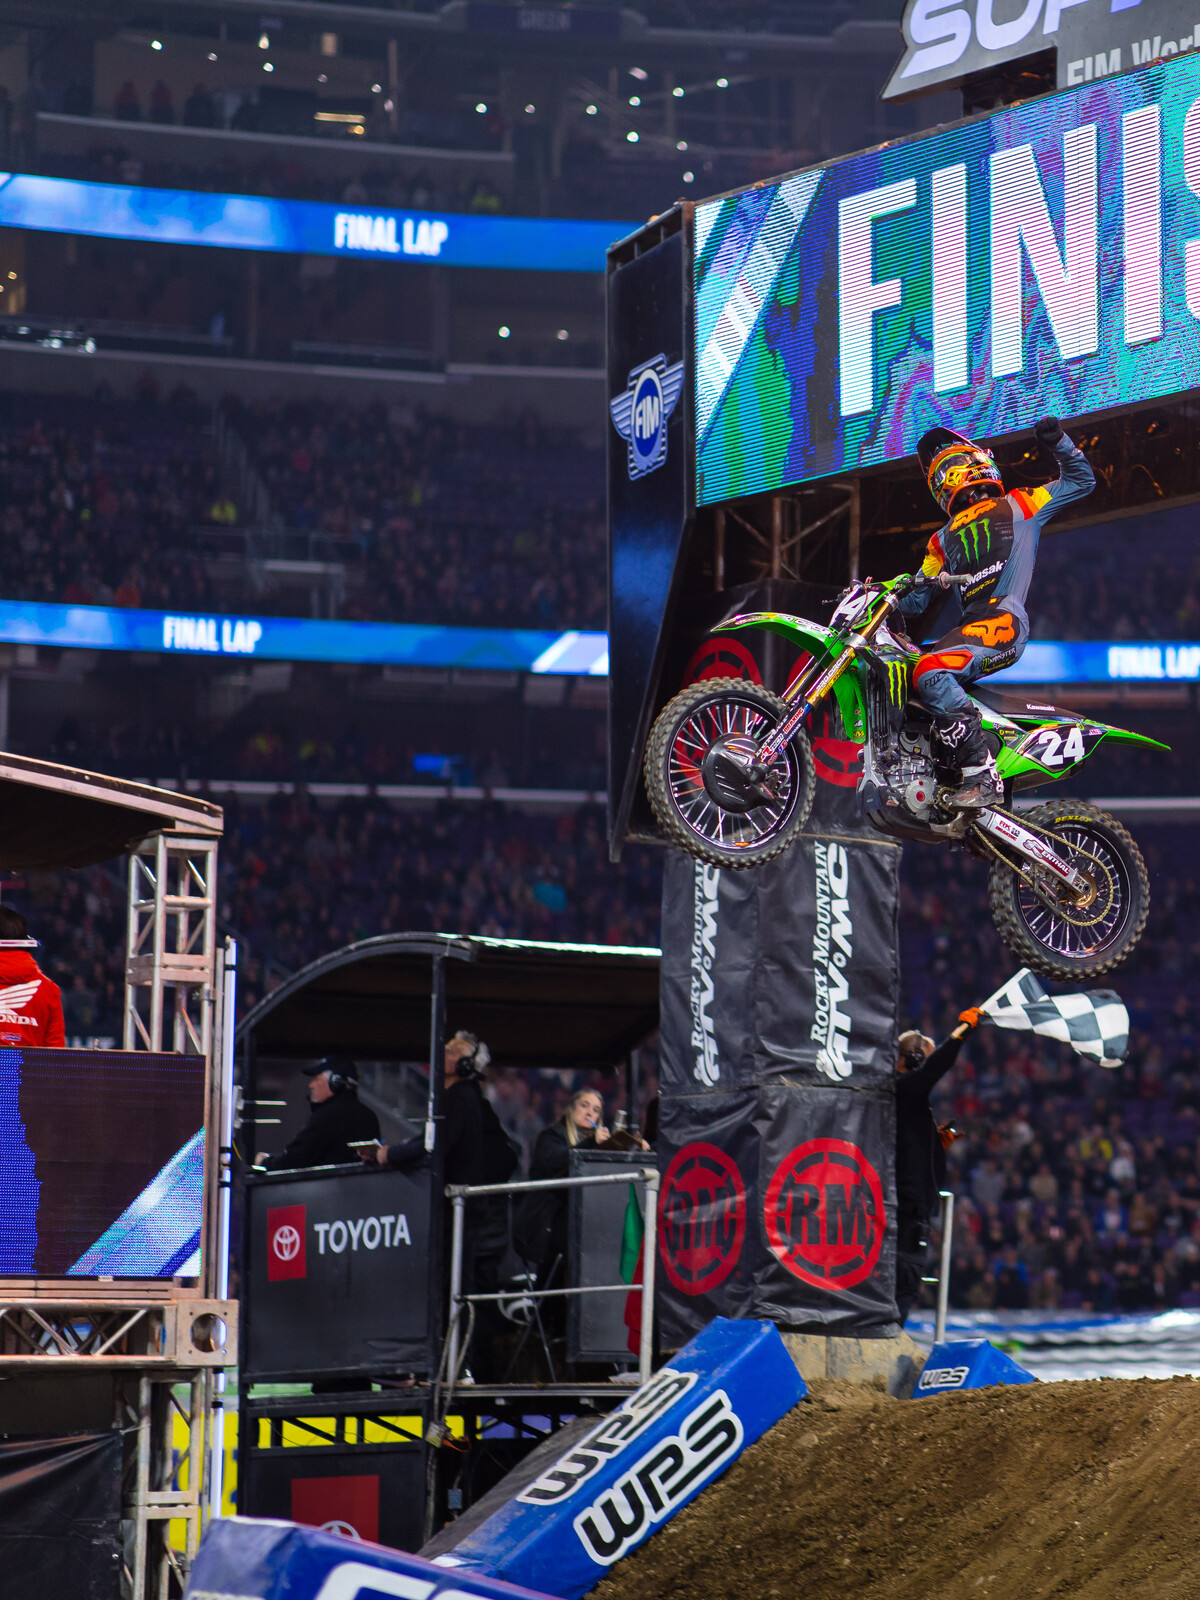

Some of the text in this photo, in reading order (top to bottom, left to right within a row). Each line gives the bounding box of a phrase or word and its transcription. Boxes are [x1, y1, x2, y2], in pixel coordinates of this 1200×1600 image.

[1067, 48, 1122, 86] FIM
[335, 212, 448, 256] FINAL LAP
[635, 394, 660, 440] FIM
[163, 615, 262, 653] FINAL LAP
[1108, 646, 1165, 678] FINAL
[782, 706, 805, 735] BRAKING
[1038, 727, 1085, 767] 24
[1054, 815, 1093, 825] DUNLOP
[690, 859, 705, 1050] ROCKY MOUNTAI
[810, 840, 832, 1046] ROCKY MOUNTAIN
[313, 1213, 412, 1255] TOYOTA
[918, 1366, 968, 1390] WPS
[523, 1369, 695, 1503] WPS
[577, 1394, 742, 1563] WPS
